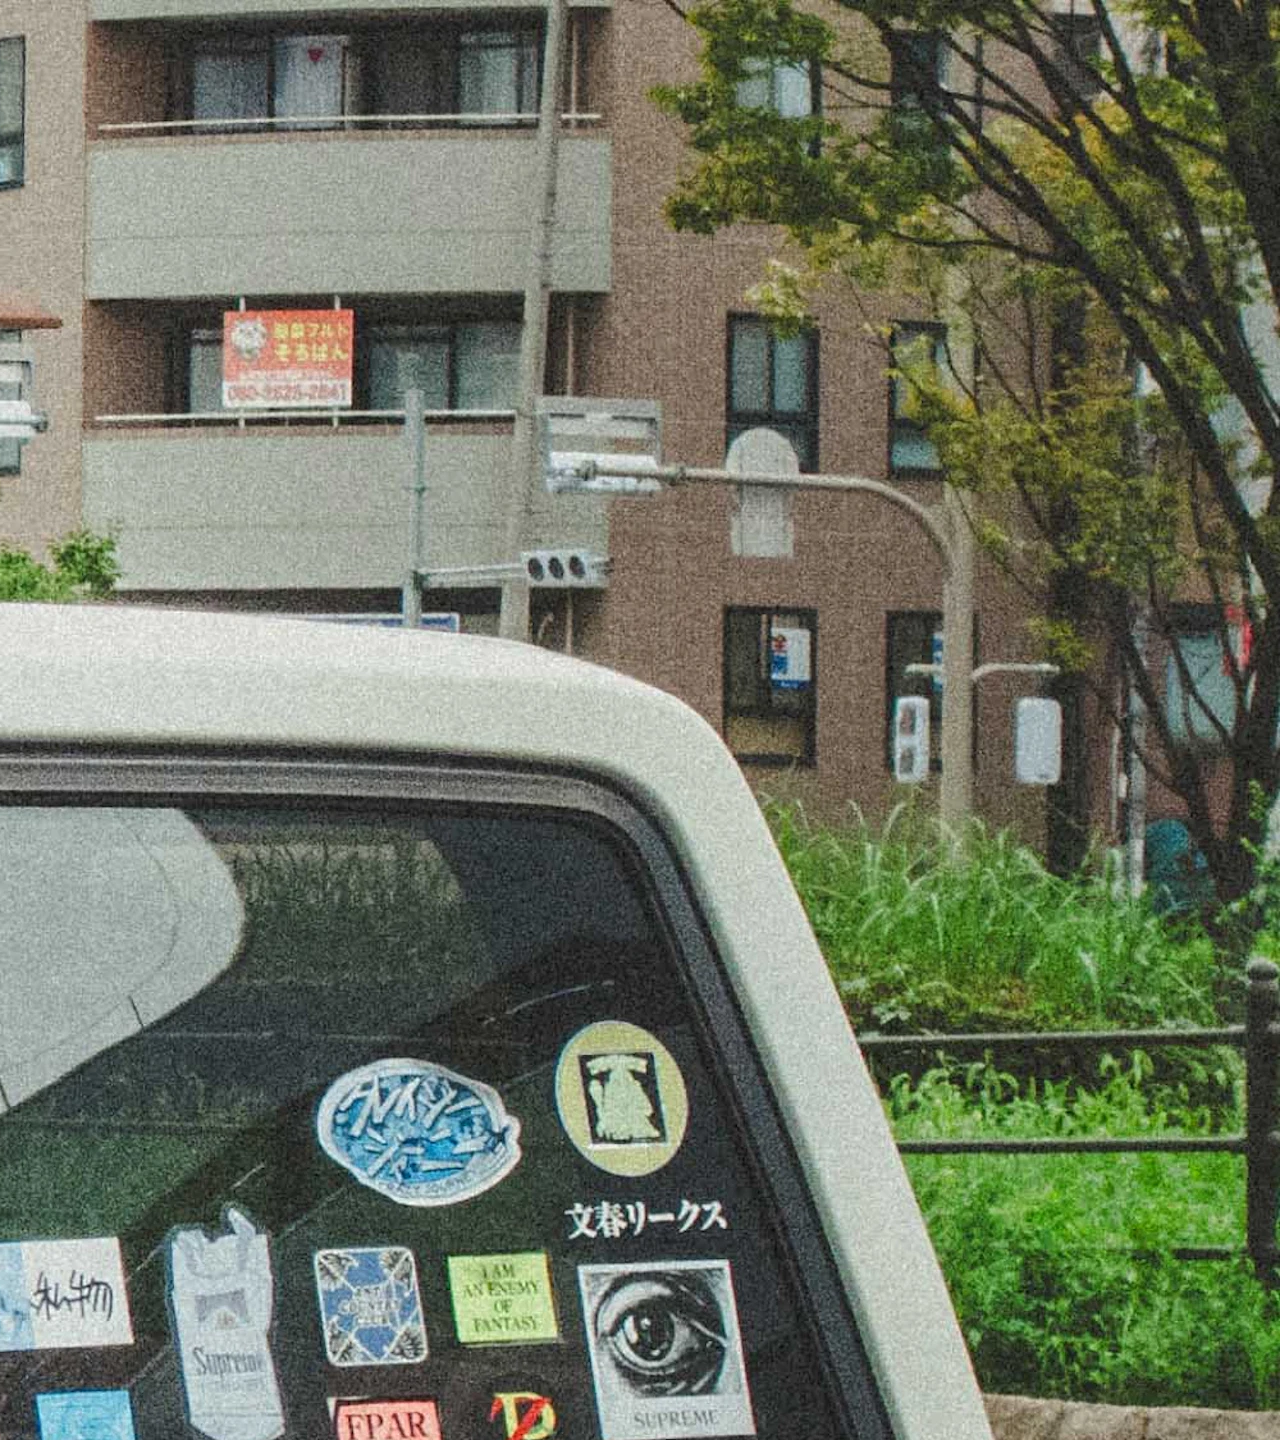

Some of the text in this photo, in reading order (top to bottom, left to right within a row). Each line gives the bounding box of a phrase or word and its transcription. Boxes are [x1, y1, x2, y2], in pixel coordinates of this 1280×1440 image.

[564, 1198, 729, 1240] 文春リークス
[492, 1263, 516, 1279] AM
[486, 1279, 539, 1297] ENEMY
[493, 1298, 513, 1313] OF
[472, 1315, 538, 1333] FANTASY
[632, 1409, 720, 1429] SUPREME
